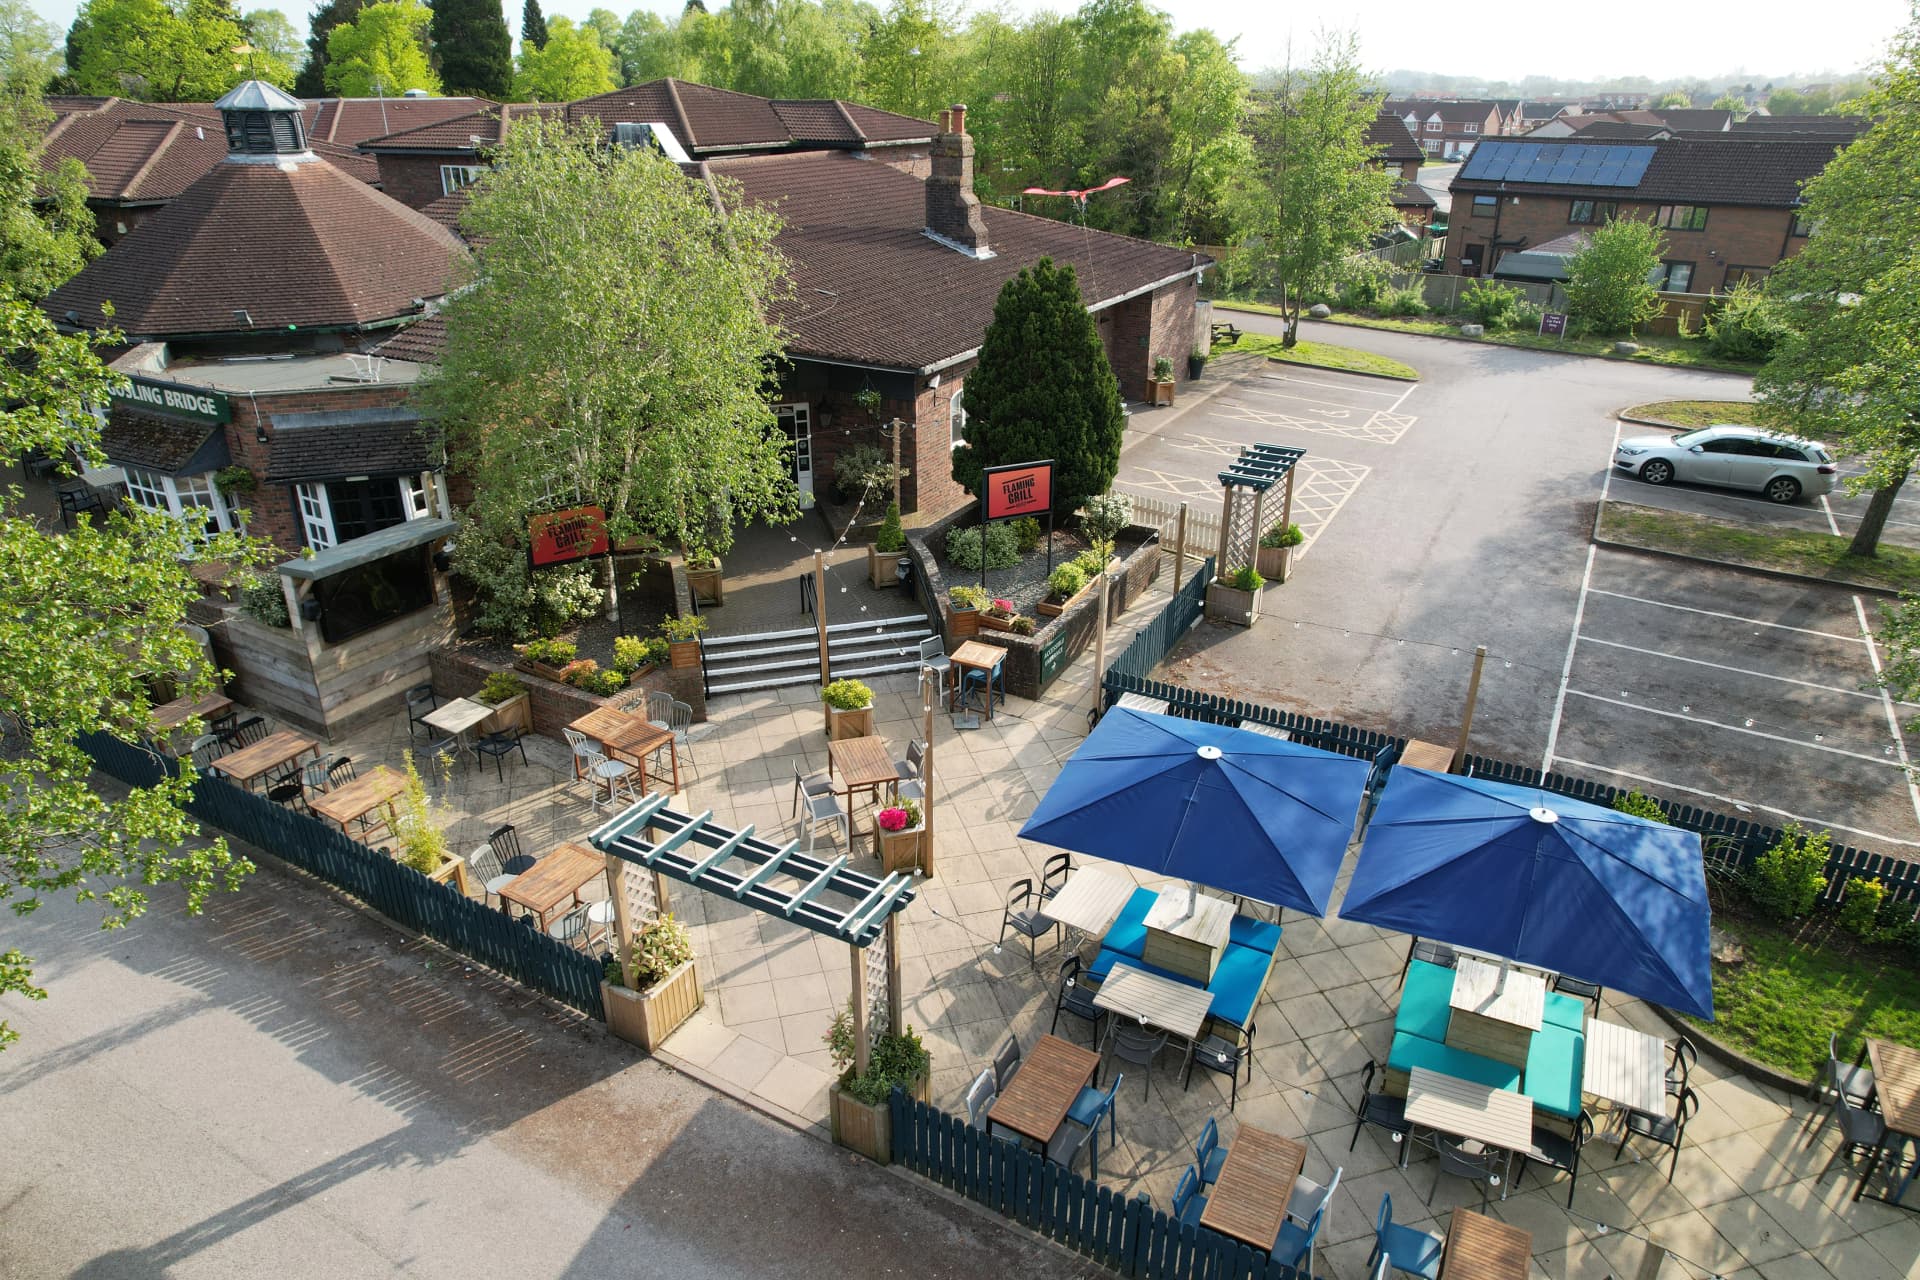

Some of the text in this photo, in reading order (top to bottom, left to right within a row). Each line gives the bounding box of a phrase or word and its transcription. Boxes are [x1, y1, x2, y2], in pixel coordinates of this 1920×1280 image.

[164, 389, 218, 416] BRIDGE
[1003, 478, 1035, 495] FLAMING
[1008, 488, 1033, 505] GRILL
